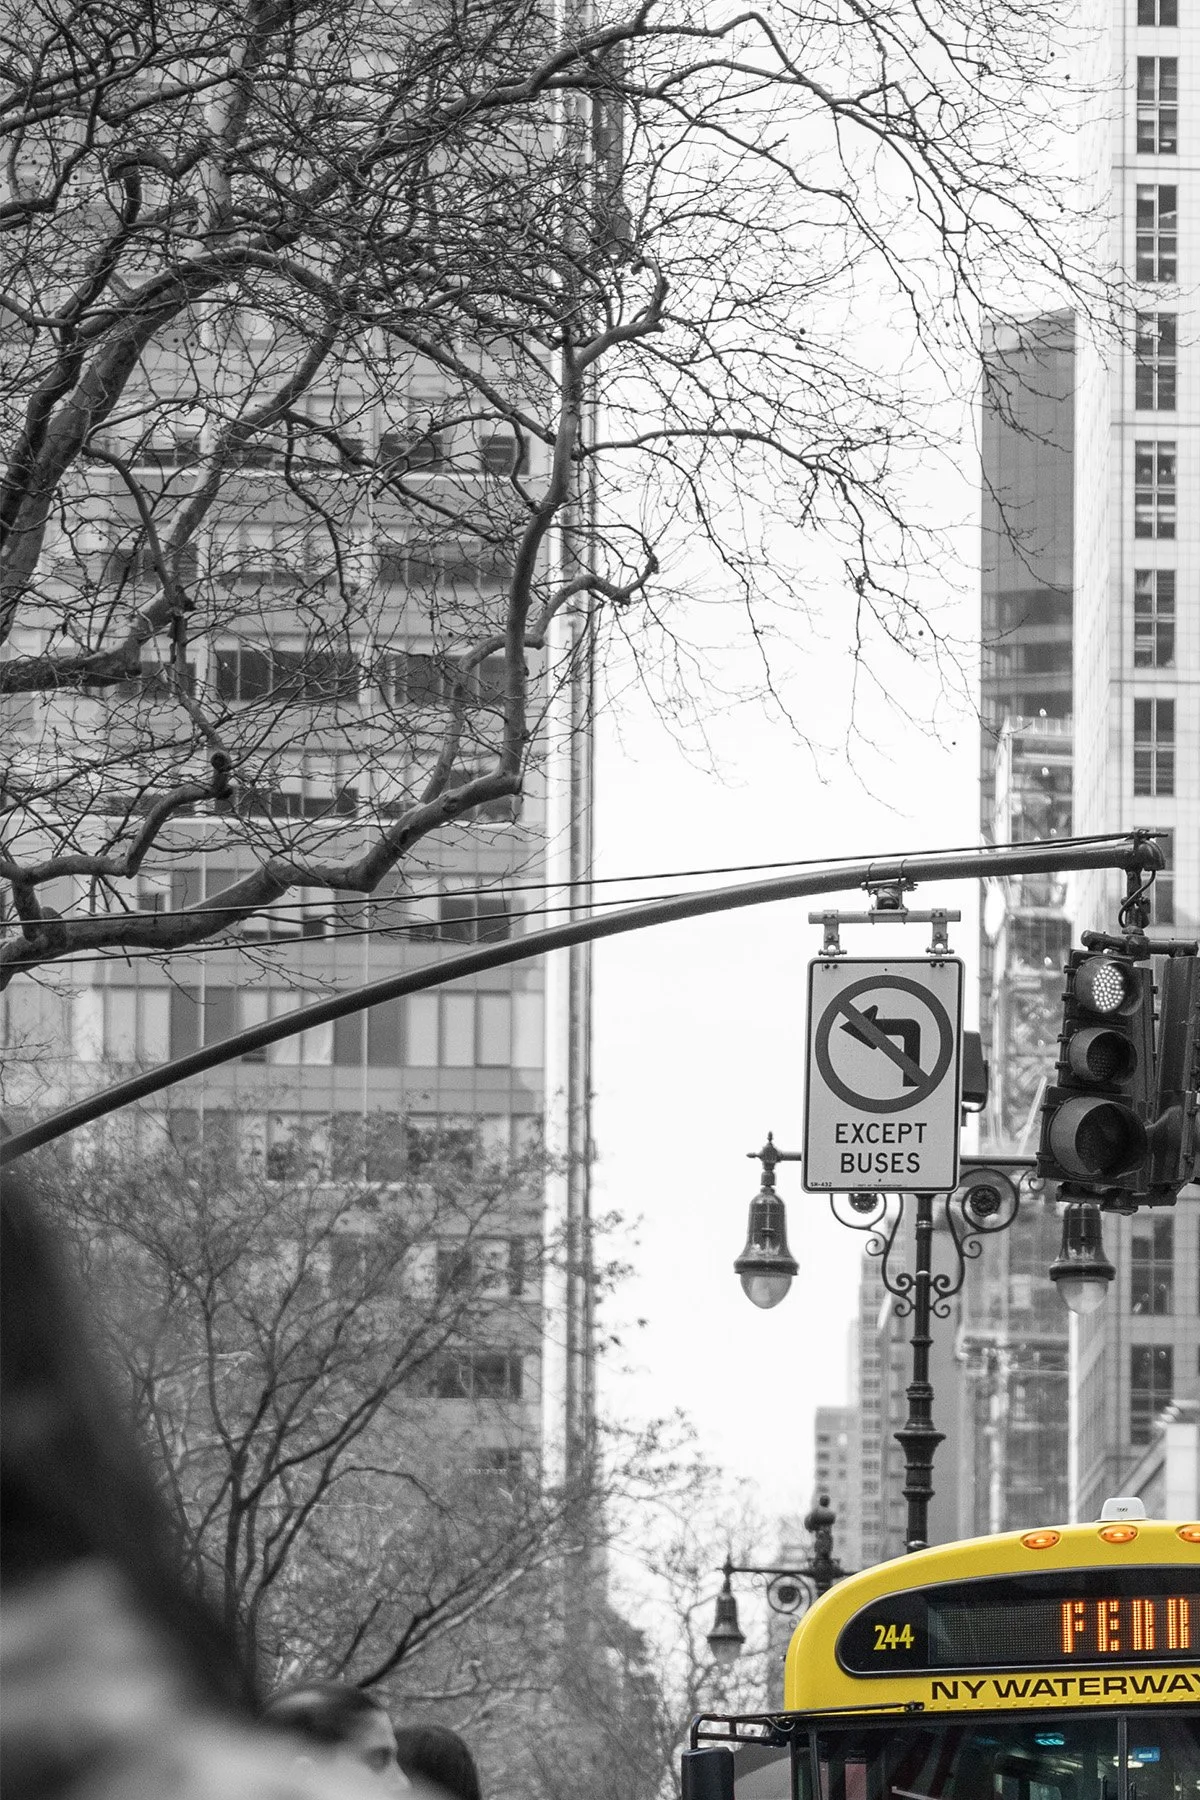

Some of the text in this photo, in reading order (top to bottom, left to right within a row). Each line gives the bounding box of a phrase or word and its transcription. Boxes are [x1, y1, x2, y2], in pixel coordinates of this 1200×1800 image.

[835, 1122, 928, 1144] EXCEPT
[840, 1152, 921, 1174] BUSES
[873, 1623, 915, 1651] 244
